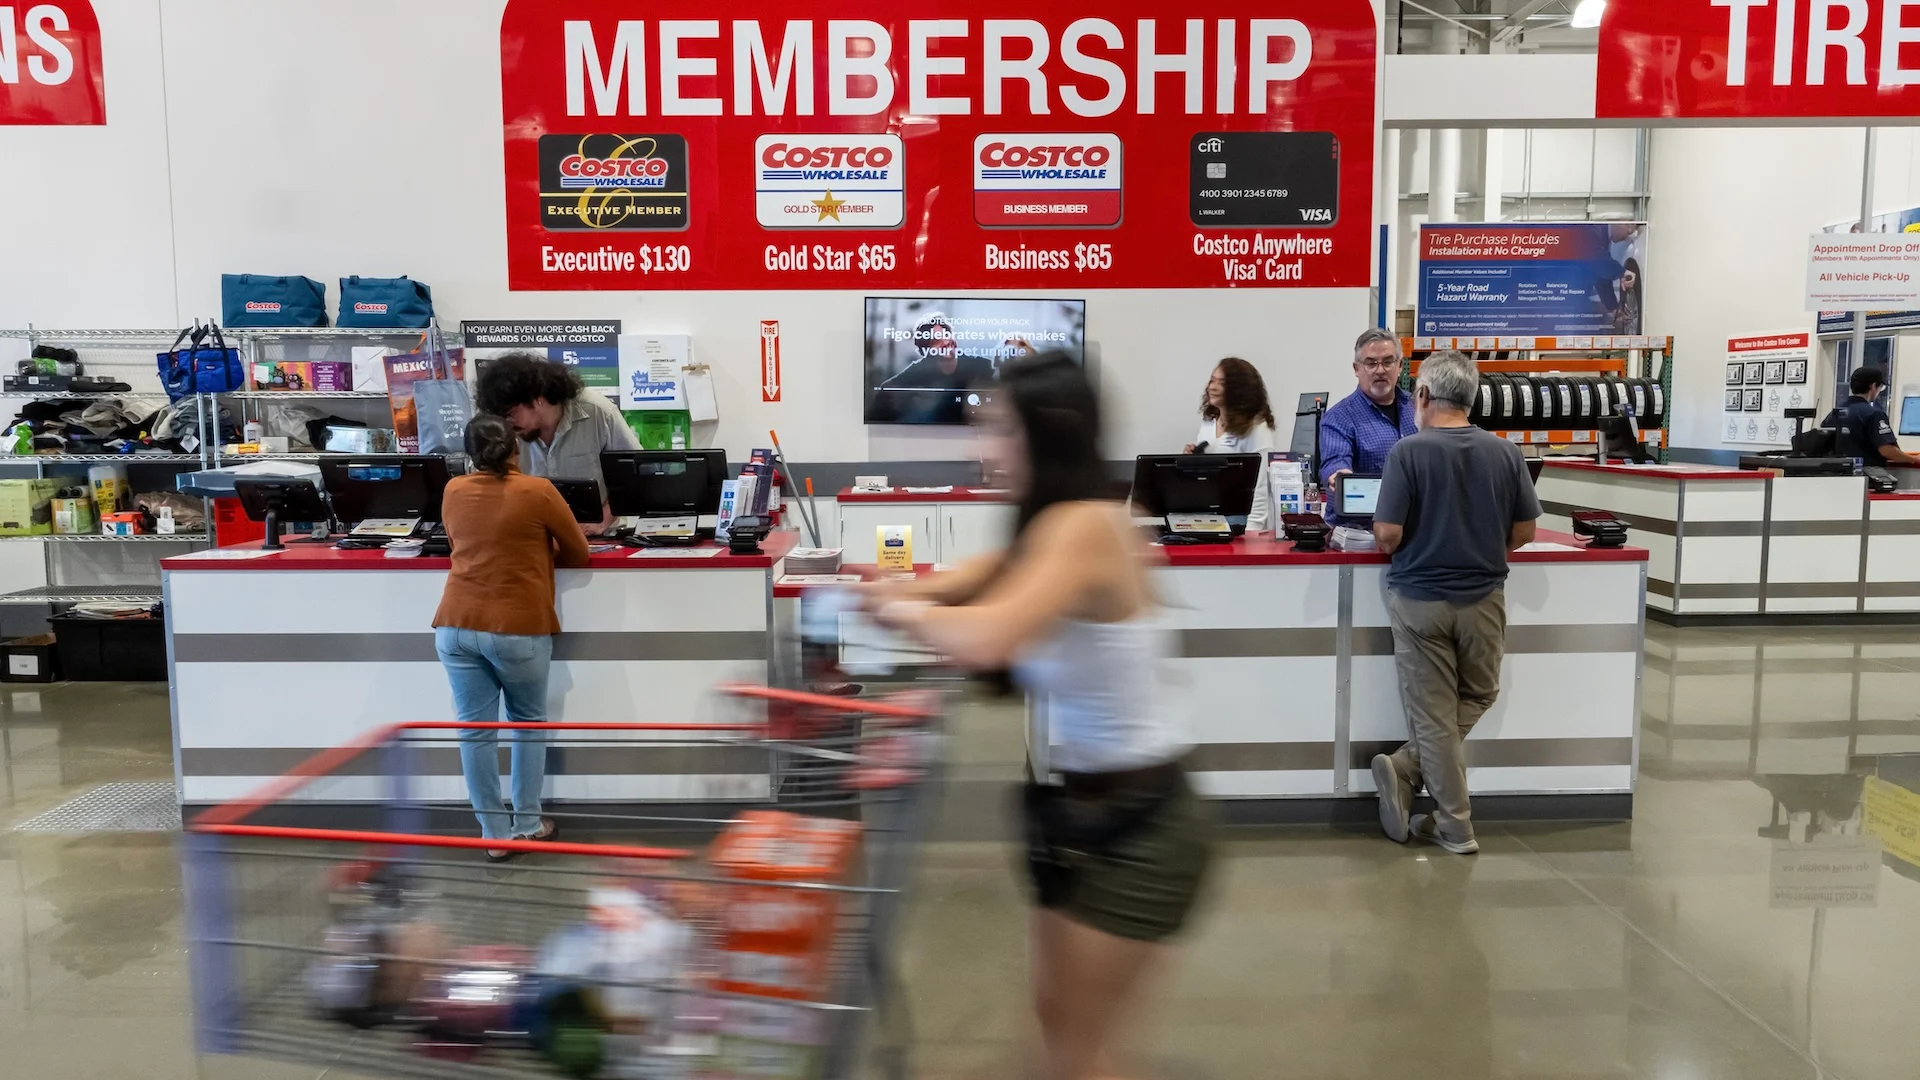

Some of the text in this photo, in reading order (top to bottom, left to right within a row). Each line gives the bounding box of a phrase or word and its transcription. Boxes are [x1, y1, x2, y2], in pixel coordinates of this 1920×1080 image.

[563, 17, 1313, 118] MEMBERSHIP
[762, 143, 893, 168] COSTCO
[979, 142, 1110, 168] COSTCO
[560, 154, 667, 177] COSTCO
[803, 170, 888, 180] WHOLESALE
[1020, 169, 1107, 179] WHOLESALE
[594, 178, 664, 186] WHOLESALE
[1199, 189, 1288, 198] 4100 3901 2345 6789
[547, 205, 682, 215] EXECUTIVE MEMBER
[783, 205, 874, 214] GOLD STAR MEMBER
[1003, 204, 1088, 214] BUSINESS MEMBER
[1299, 208, 1332, 221] VISA
[1429, 232, 1560, 245] Tire Purchase Includes
[1193, 233, 1332, 260] Costco Anywhere
[1428, 246, 1546, 257] Installation at No Charge
[1814, 244, 1920, 254] Appointment Drop Off
[541, 243, 691, 275] Executive $130
[764, 242, 896, 274] Gold Star $65
[985, 241, 1113, 273] Business $65
[1264, 258, 1303, 280] Card
[1820, 272, 1910, 283] All Vehicle Pick-Up
[1437, 283, 1490, 292] 5-Year Road
[1436, 293, 1508, 303] Hazard Warranty
[466, 325, 616, 334] NOW EARN EVEN MORE CASH BACK
[883, 328, 1066, 342] Figo celebrates what makes
[476, 334, 606, 343] REWARDS ON GAS AT COSTCO
[922, 346, 1026, 359] your pet unique
